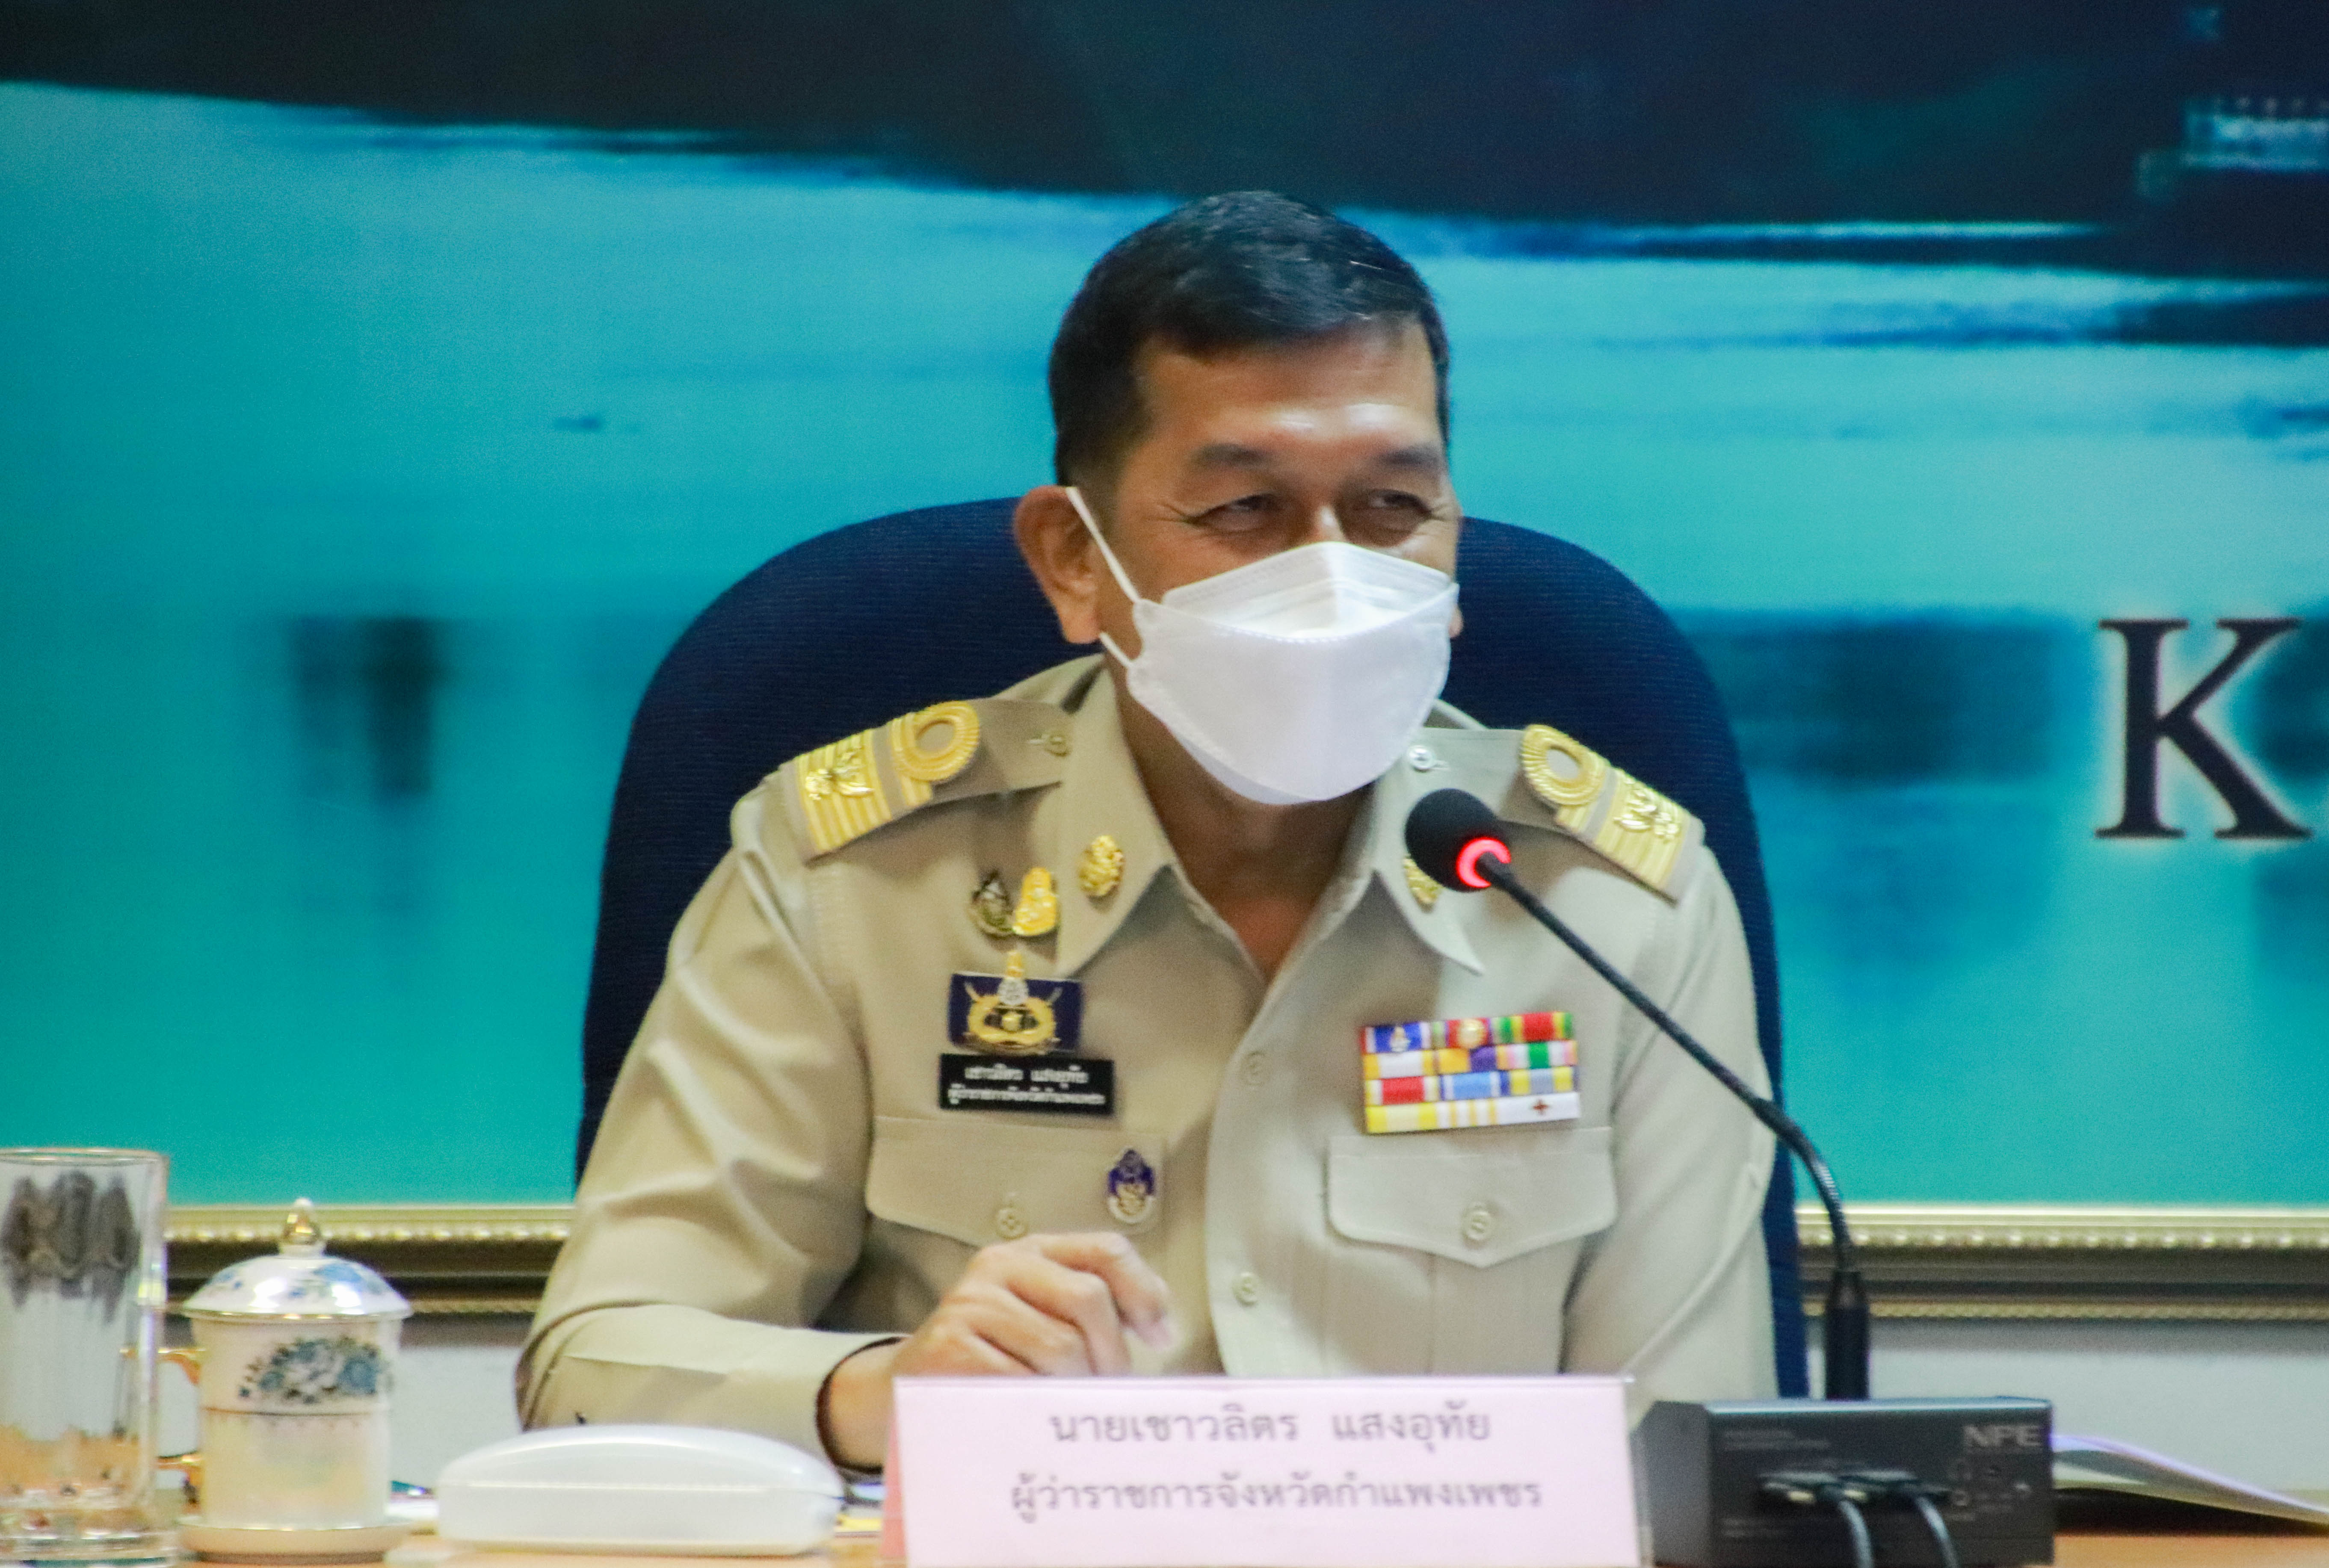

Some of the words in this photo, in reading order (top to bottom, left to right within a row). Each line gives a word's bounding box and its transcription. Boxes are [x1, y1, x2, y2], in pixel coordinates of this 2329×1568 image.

[2095, 618, 2314, 839] K
[1049, 1402, 1298, 1441] นายเชาวลิตร
[1331, 1400, 1491, 1453] แสงอุทัย
[1011, 1470, 1542, 1523] ผู้ว่าราชการจังหวัดกำแพงเพชร
